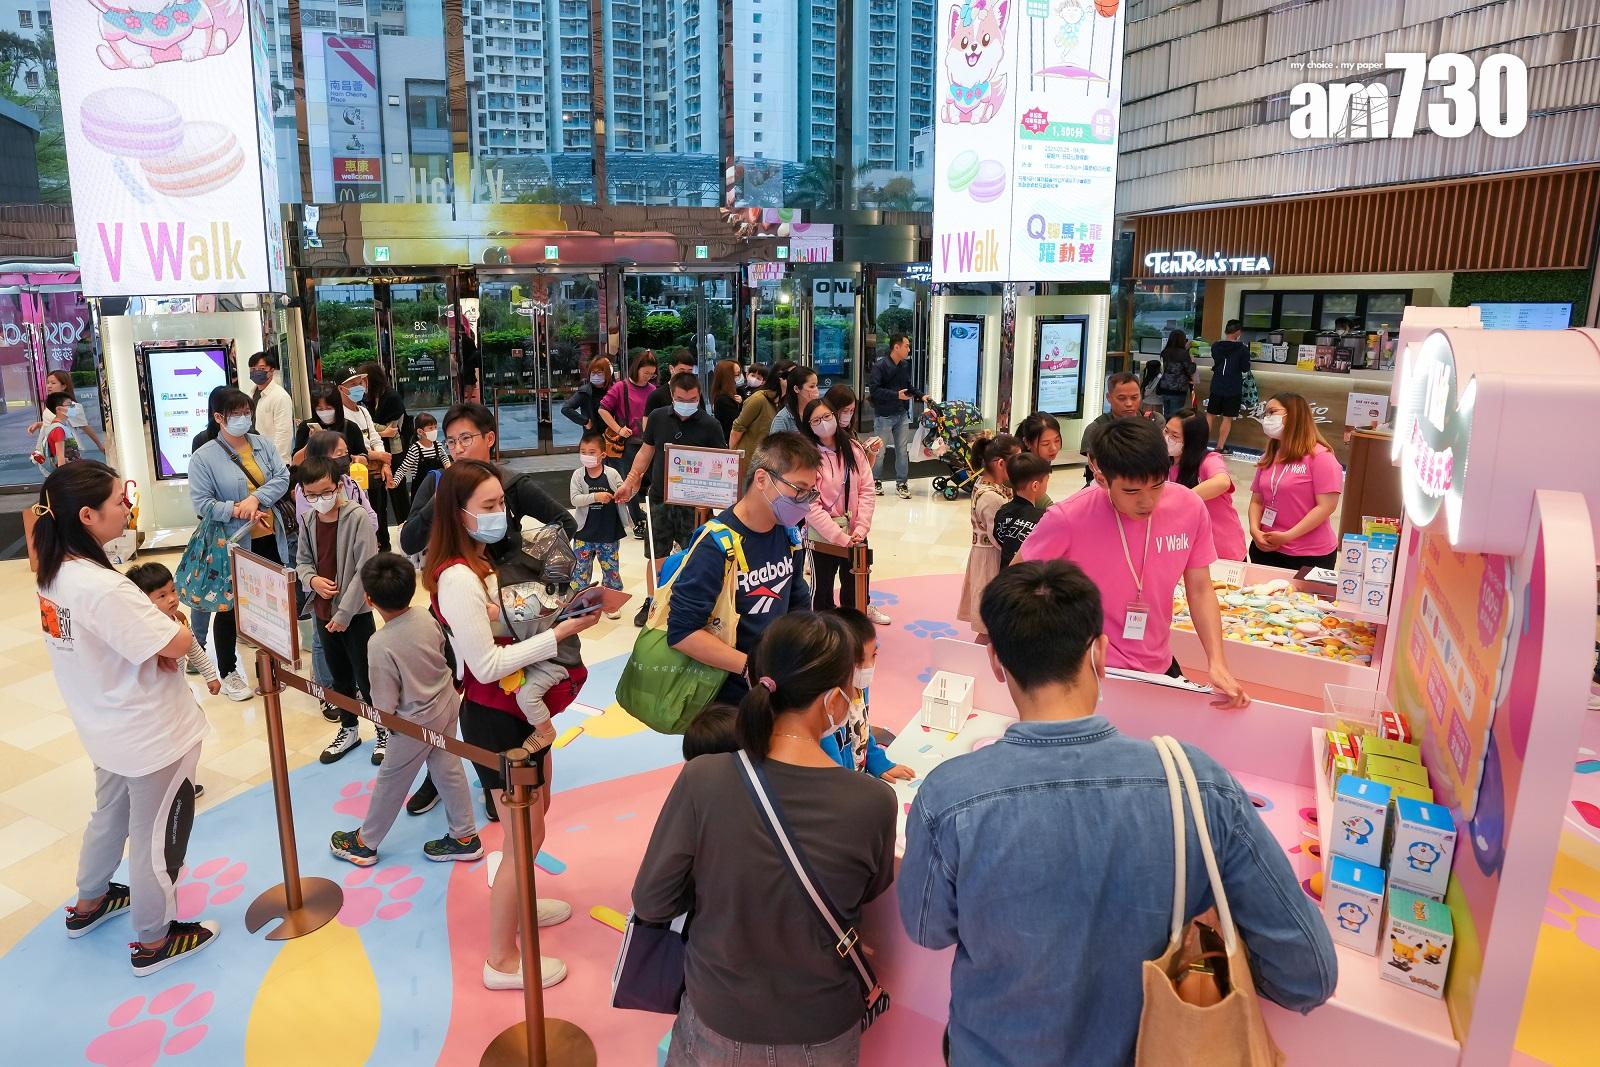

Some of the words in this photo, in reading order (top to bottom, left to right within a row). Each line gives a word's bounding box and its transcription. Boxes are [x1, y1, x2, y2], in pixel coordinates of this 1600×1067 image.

[345, 160, 369, 173] 惠康
[97, 222, 123, 282] V
[140, 221, 247, 281] Walk
[941, 233, 951, 273] V
[957, 229, 999, 273] Walk
[1228, 257, 1271, 272] TEA
[1291, 463, 1306, 474] Walk
[1156, 537, 1163, 553] V
[1165, 533, 1189, 552] Walk
[736, 555, 794, 593] Reebok
[305, 681, 311, 693] V
[311, 684, 326, 700] Walk
[360, 703, 365, 716] V
[366, 706, 381, 723] Walk
[422, 727, 427, 742] V
[428, 730, 446, 749] Walk
